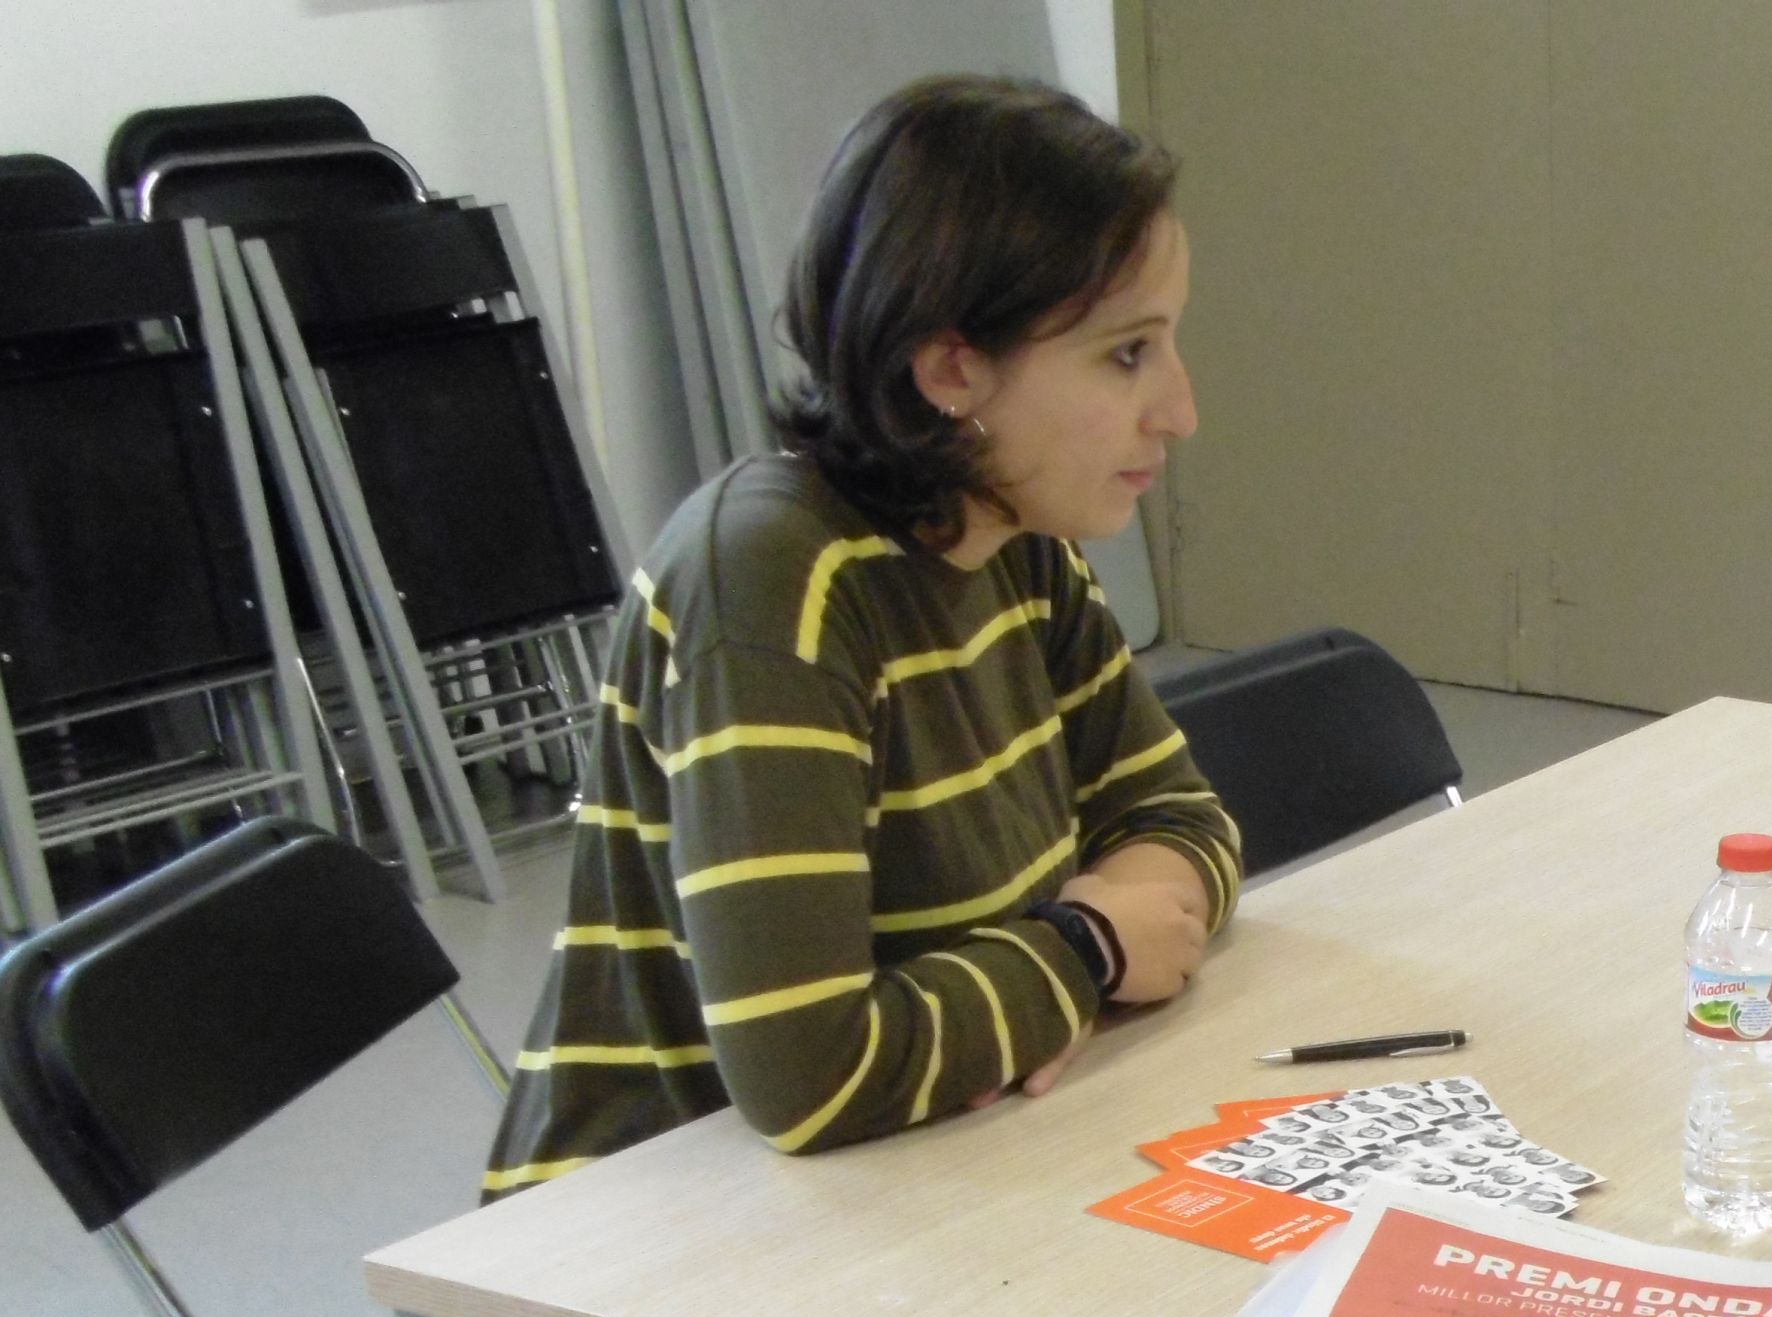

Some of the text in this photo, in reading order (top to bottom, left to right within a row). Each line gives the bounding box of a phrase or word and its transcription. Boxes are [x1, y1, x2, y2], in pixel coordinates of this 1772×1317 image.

[1693, 981, 1746, 998] Viladrau
[1434, 1244, 1622, 1298] PREMI
[1418, 1284, 1512, 1308] MILLOR
[1510, 1291, 1623, 1313] JORDI
